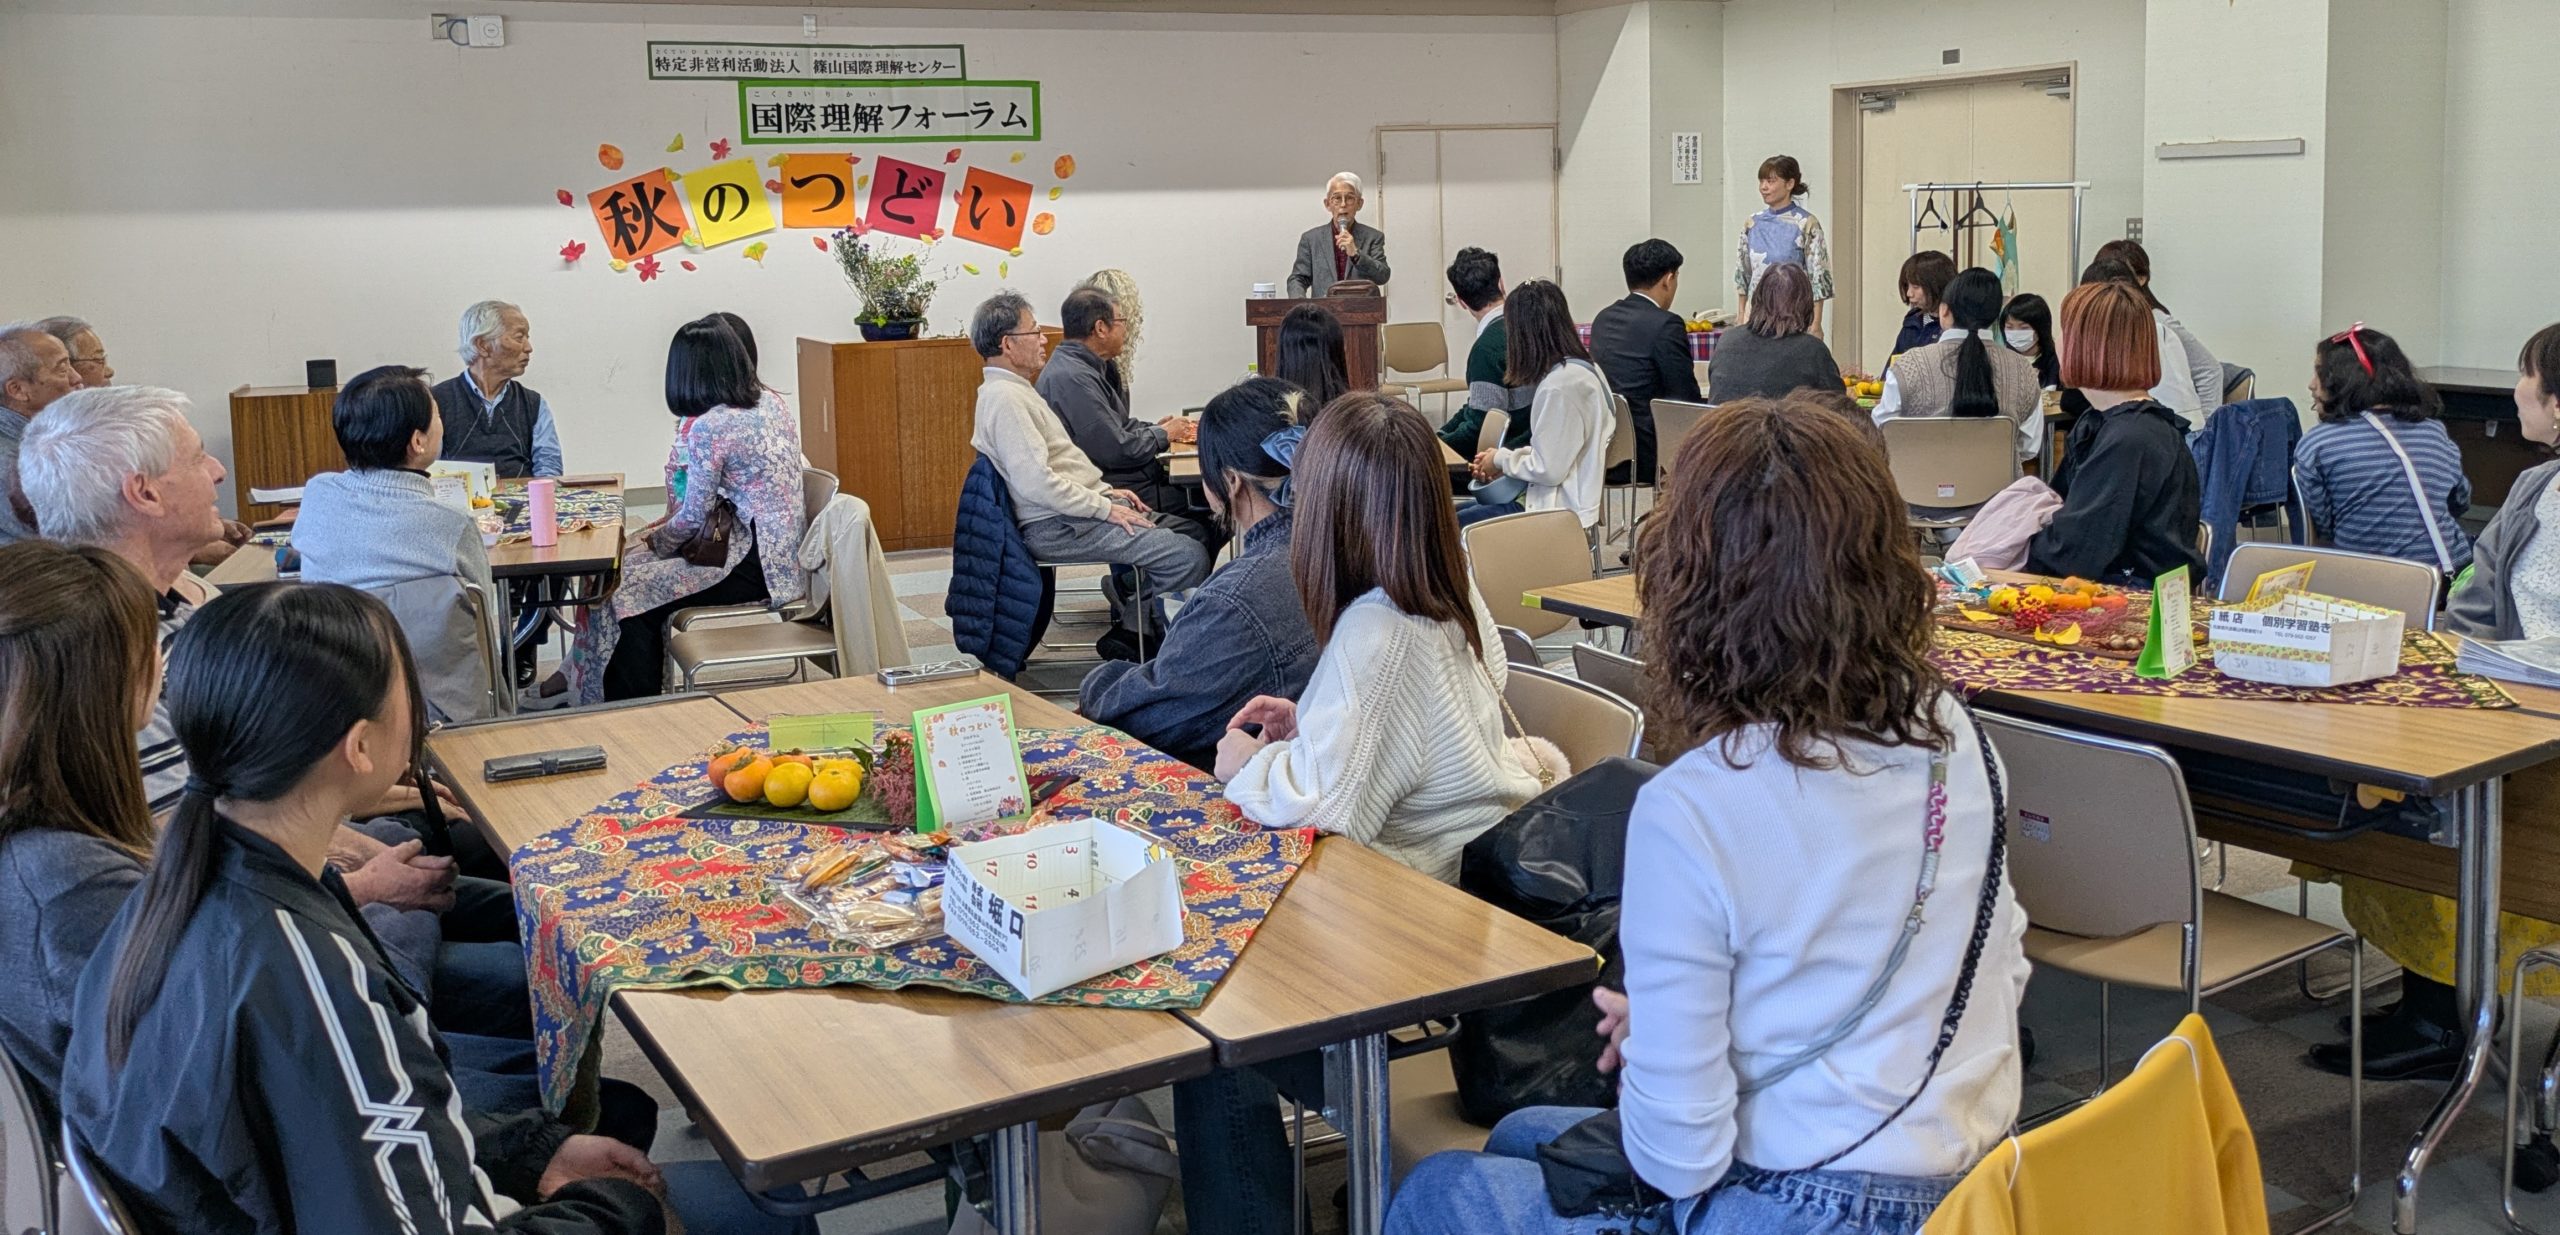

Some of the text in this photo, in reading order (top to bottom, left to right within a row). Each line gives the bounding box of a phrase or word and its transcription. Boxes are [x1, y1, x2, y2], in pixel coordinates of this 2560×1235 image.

[655, 57, 956, 75] 特定非営利活動法人 篠山国際理解センター
[752, 101, 1028, 134] 国際理解フォーラム
[600, 167, 1016, 255] 秋のつどい
[949, 722, 992, 737] 秋のつどい
[1066, 846, 1078, 854] 3
[986, 861, 998, 877] 17
[1026, 853, 1037, 869] 10
[1068, 888, 1079, 898] 4
[1025, 895, 1037, 910] 11
